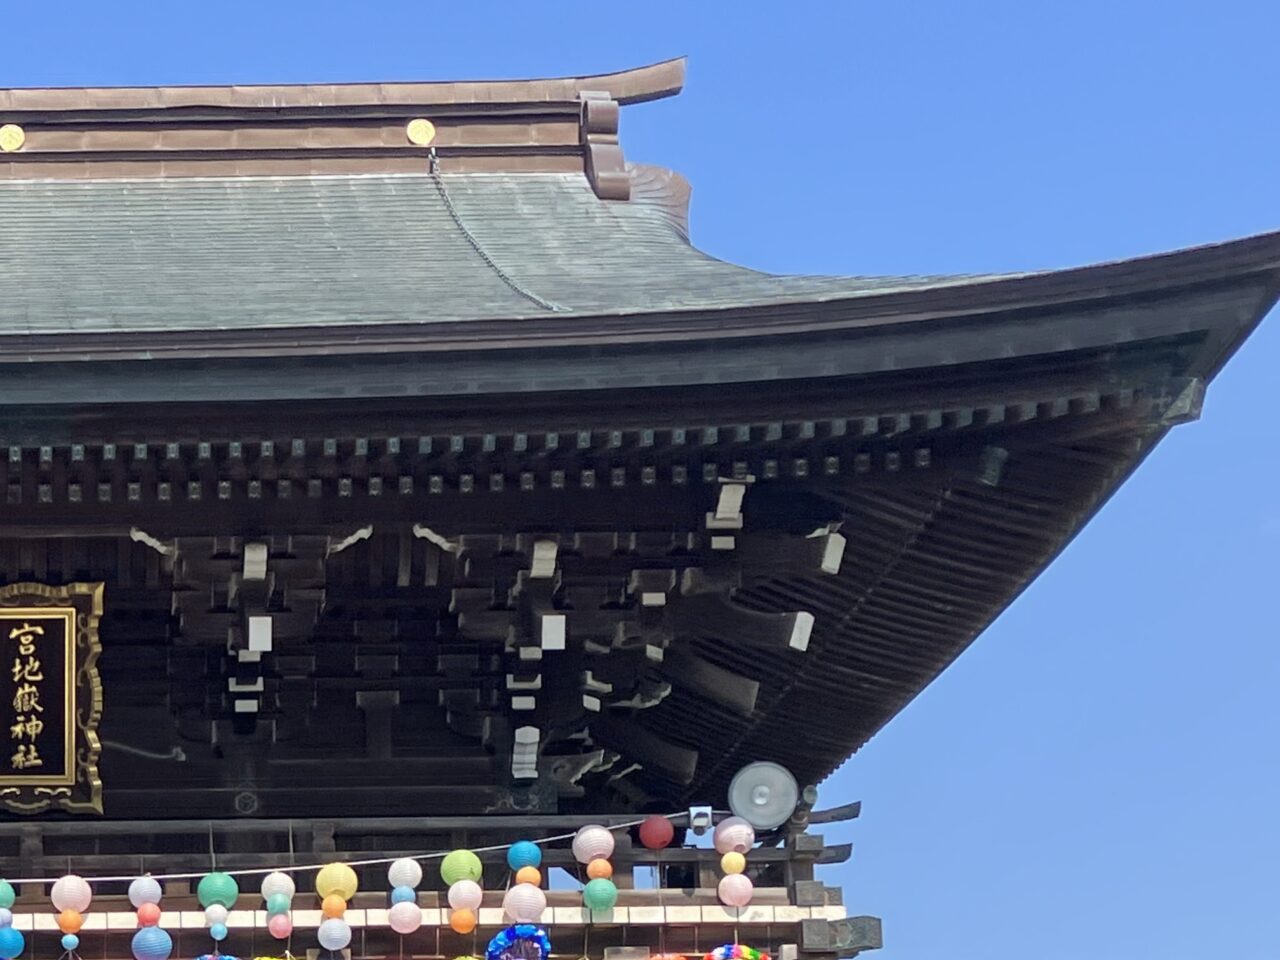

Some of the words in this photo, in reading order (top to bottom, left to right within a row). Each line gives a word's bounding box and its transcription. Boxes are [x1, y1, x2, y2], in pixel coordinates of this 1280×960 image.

[8, 623, 45, 769] 宮地嶽神社
